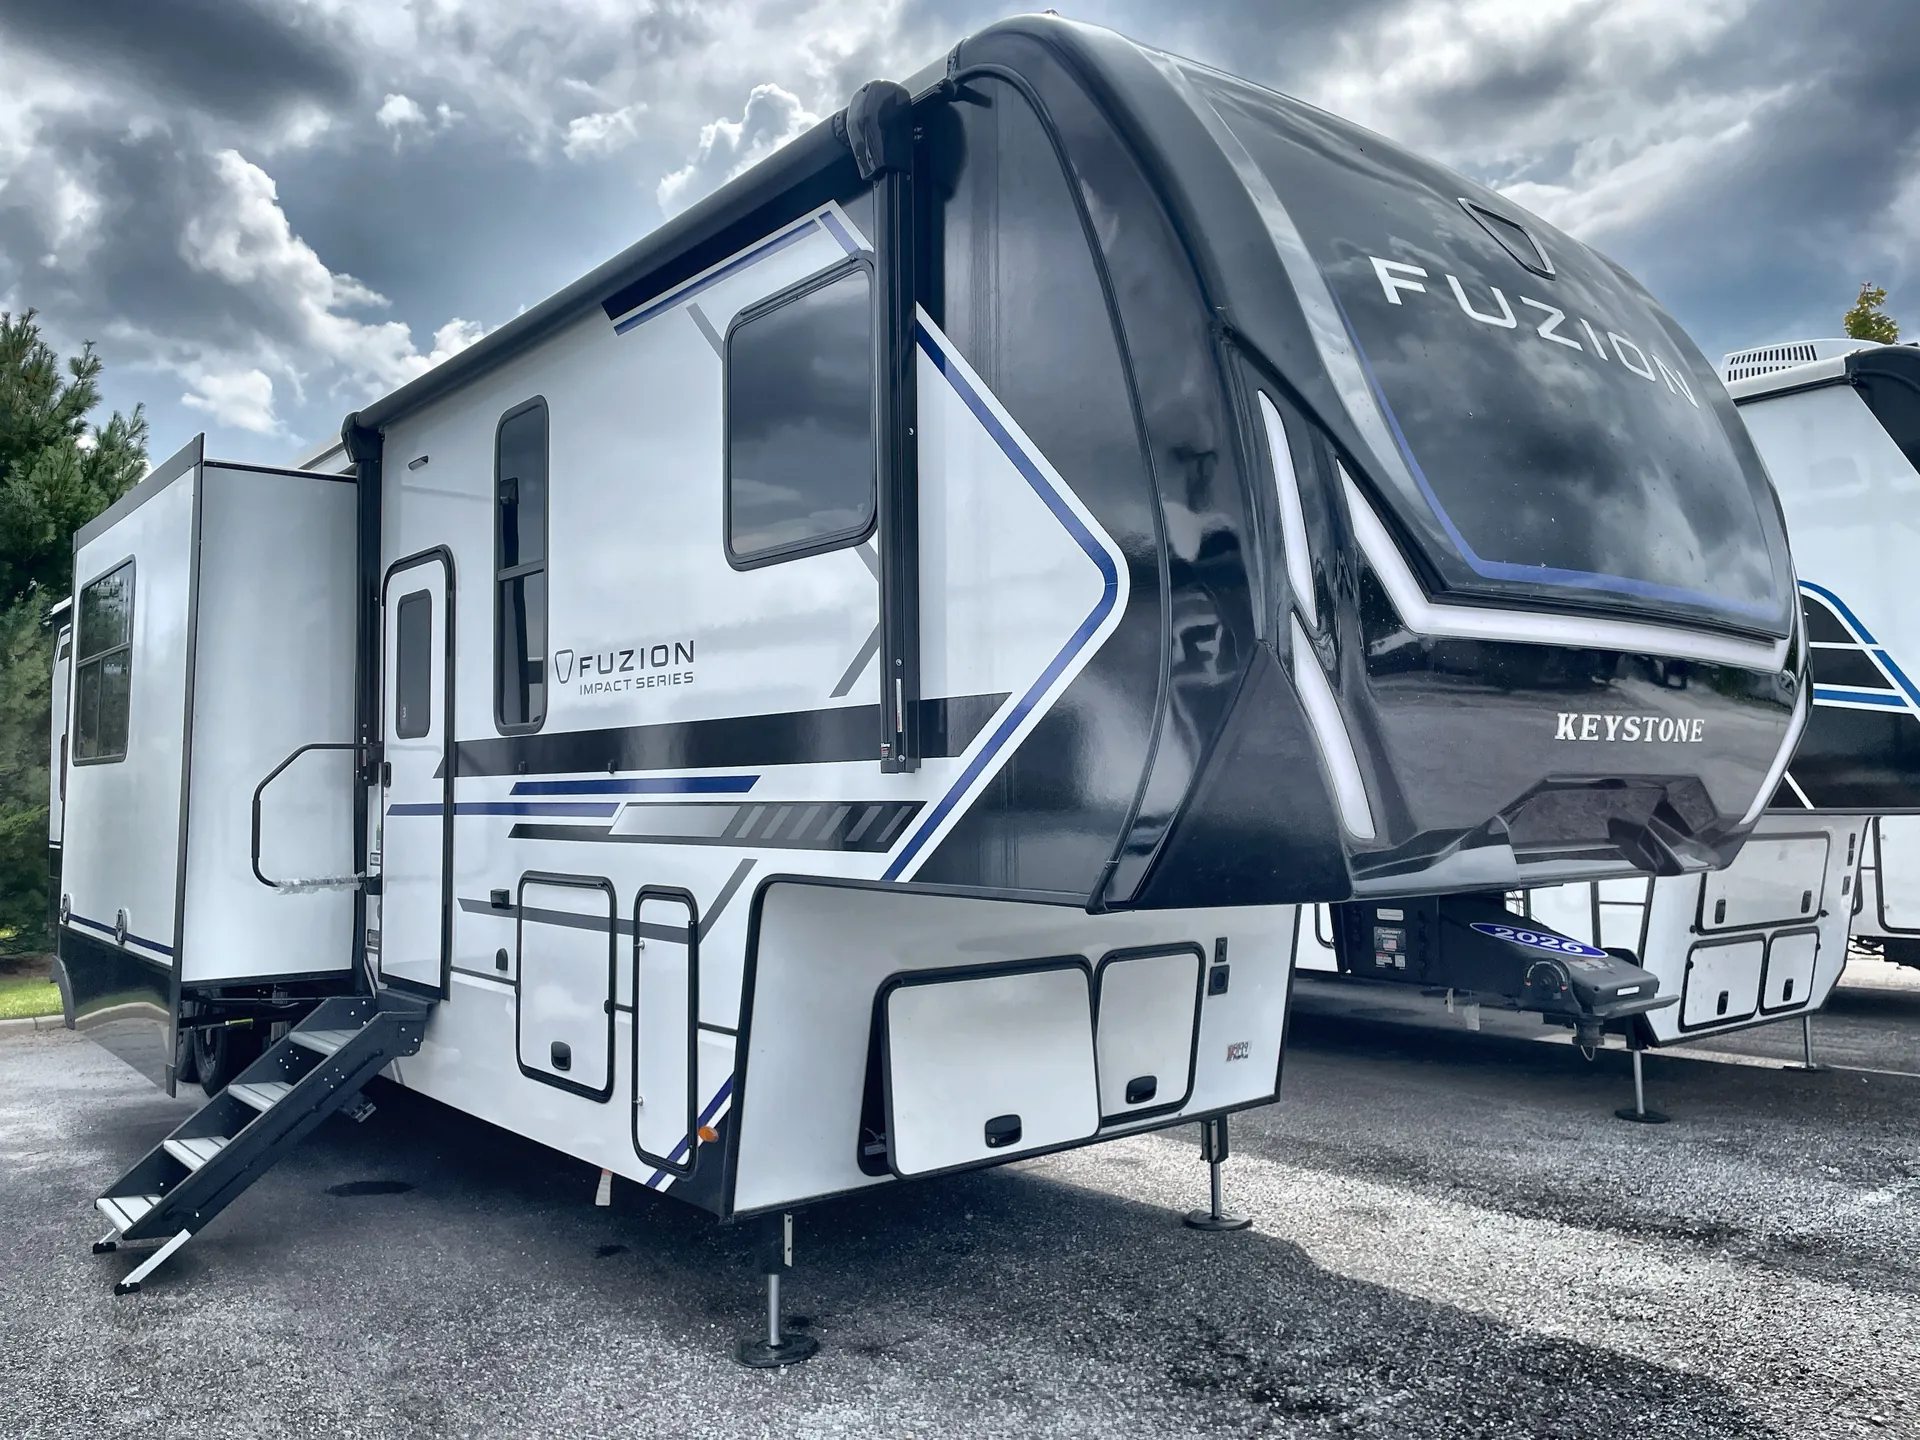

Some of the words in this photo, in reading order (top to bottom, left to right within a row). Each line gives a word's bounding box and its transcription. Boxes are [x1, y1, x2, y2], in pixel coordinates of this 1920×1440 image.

[1369, 256, 1699, 410] FUZION
[579, 639, 694, 678] FUZION
[579, 679, 632, 696] IMPACT
[636, 671, 694, 689] SERIES
[1554, 712, 1705, 743] KEYSTONE
[1494, 926, 1585, 954] 2026
